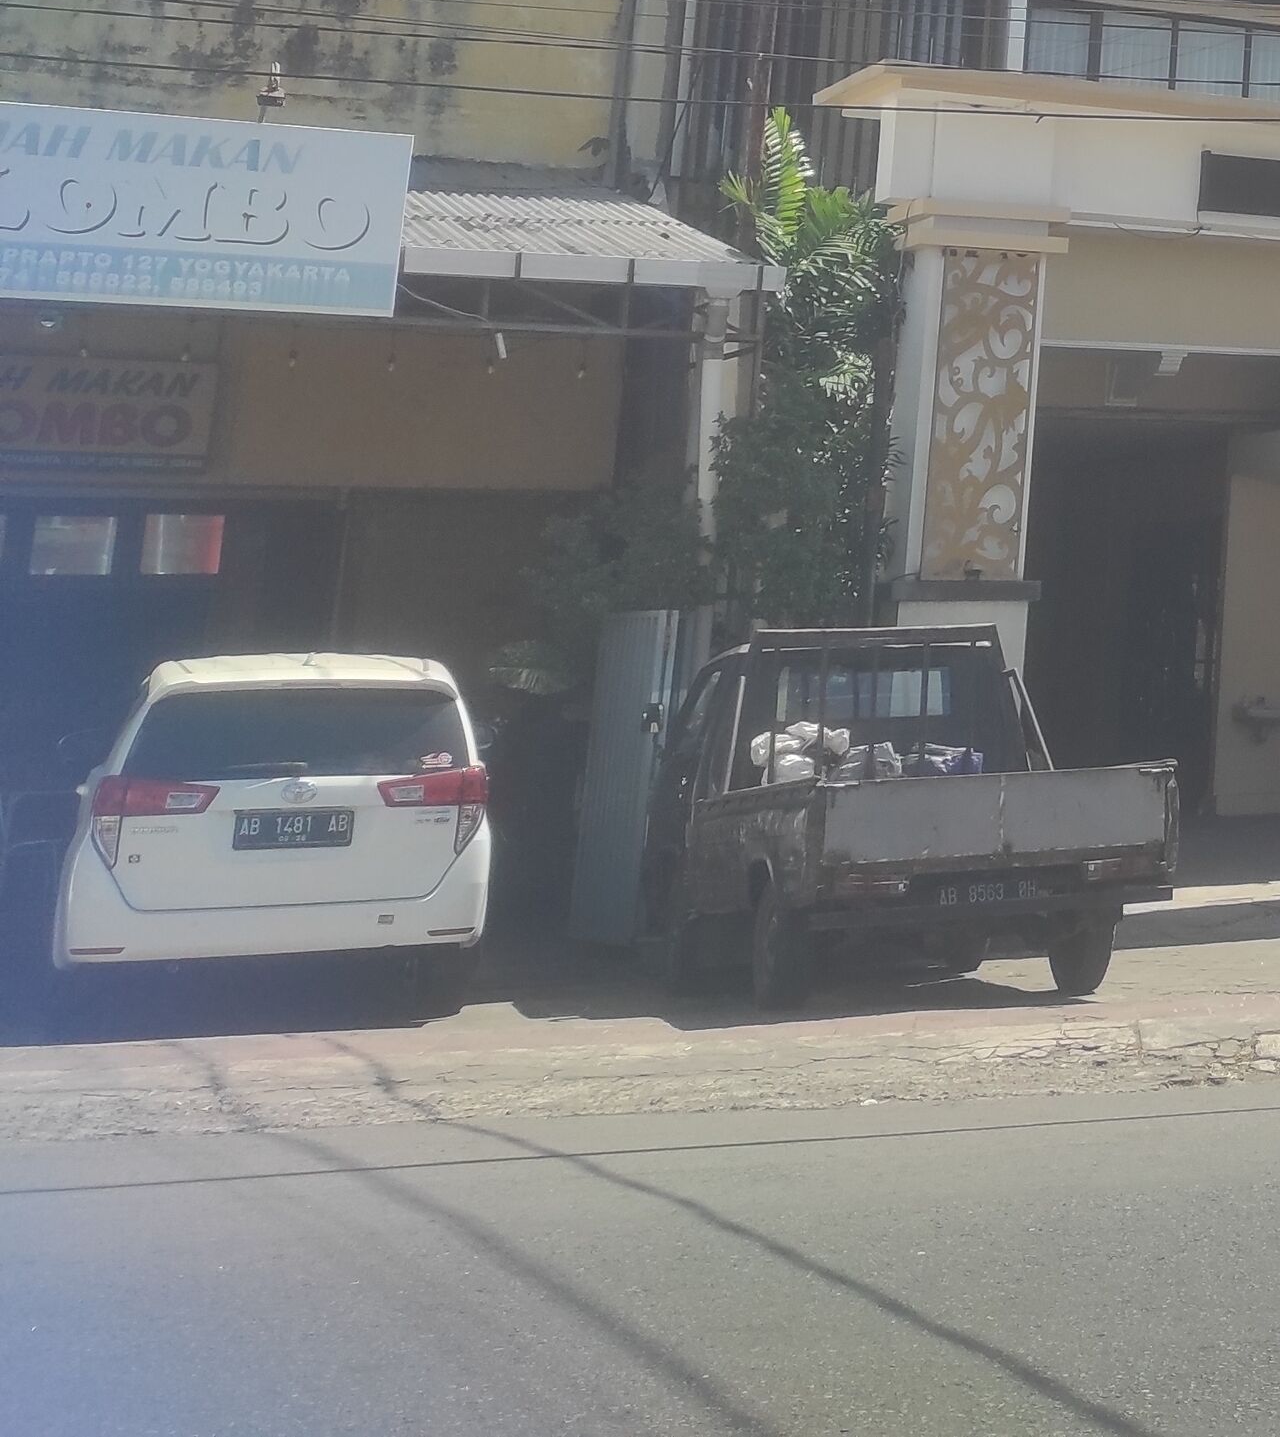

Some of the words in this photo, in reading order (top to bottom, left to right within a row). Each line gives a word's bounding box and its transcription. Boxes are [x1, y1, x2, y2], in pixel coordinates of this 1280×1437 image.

[104, 128, 304, 175] MAKAN
[123, 254, 168, 270] 127
[178, 258, 351, 282] YOGYAKARTA
[46, 368, 201, 397] MAKAN
[239, 818, 260, 835] AB
[276, 815, 312, 834] 1481
[328, 814, 349, 832] AB
[939, 888, 957, 905] AB
